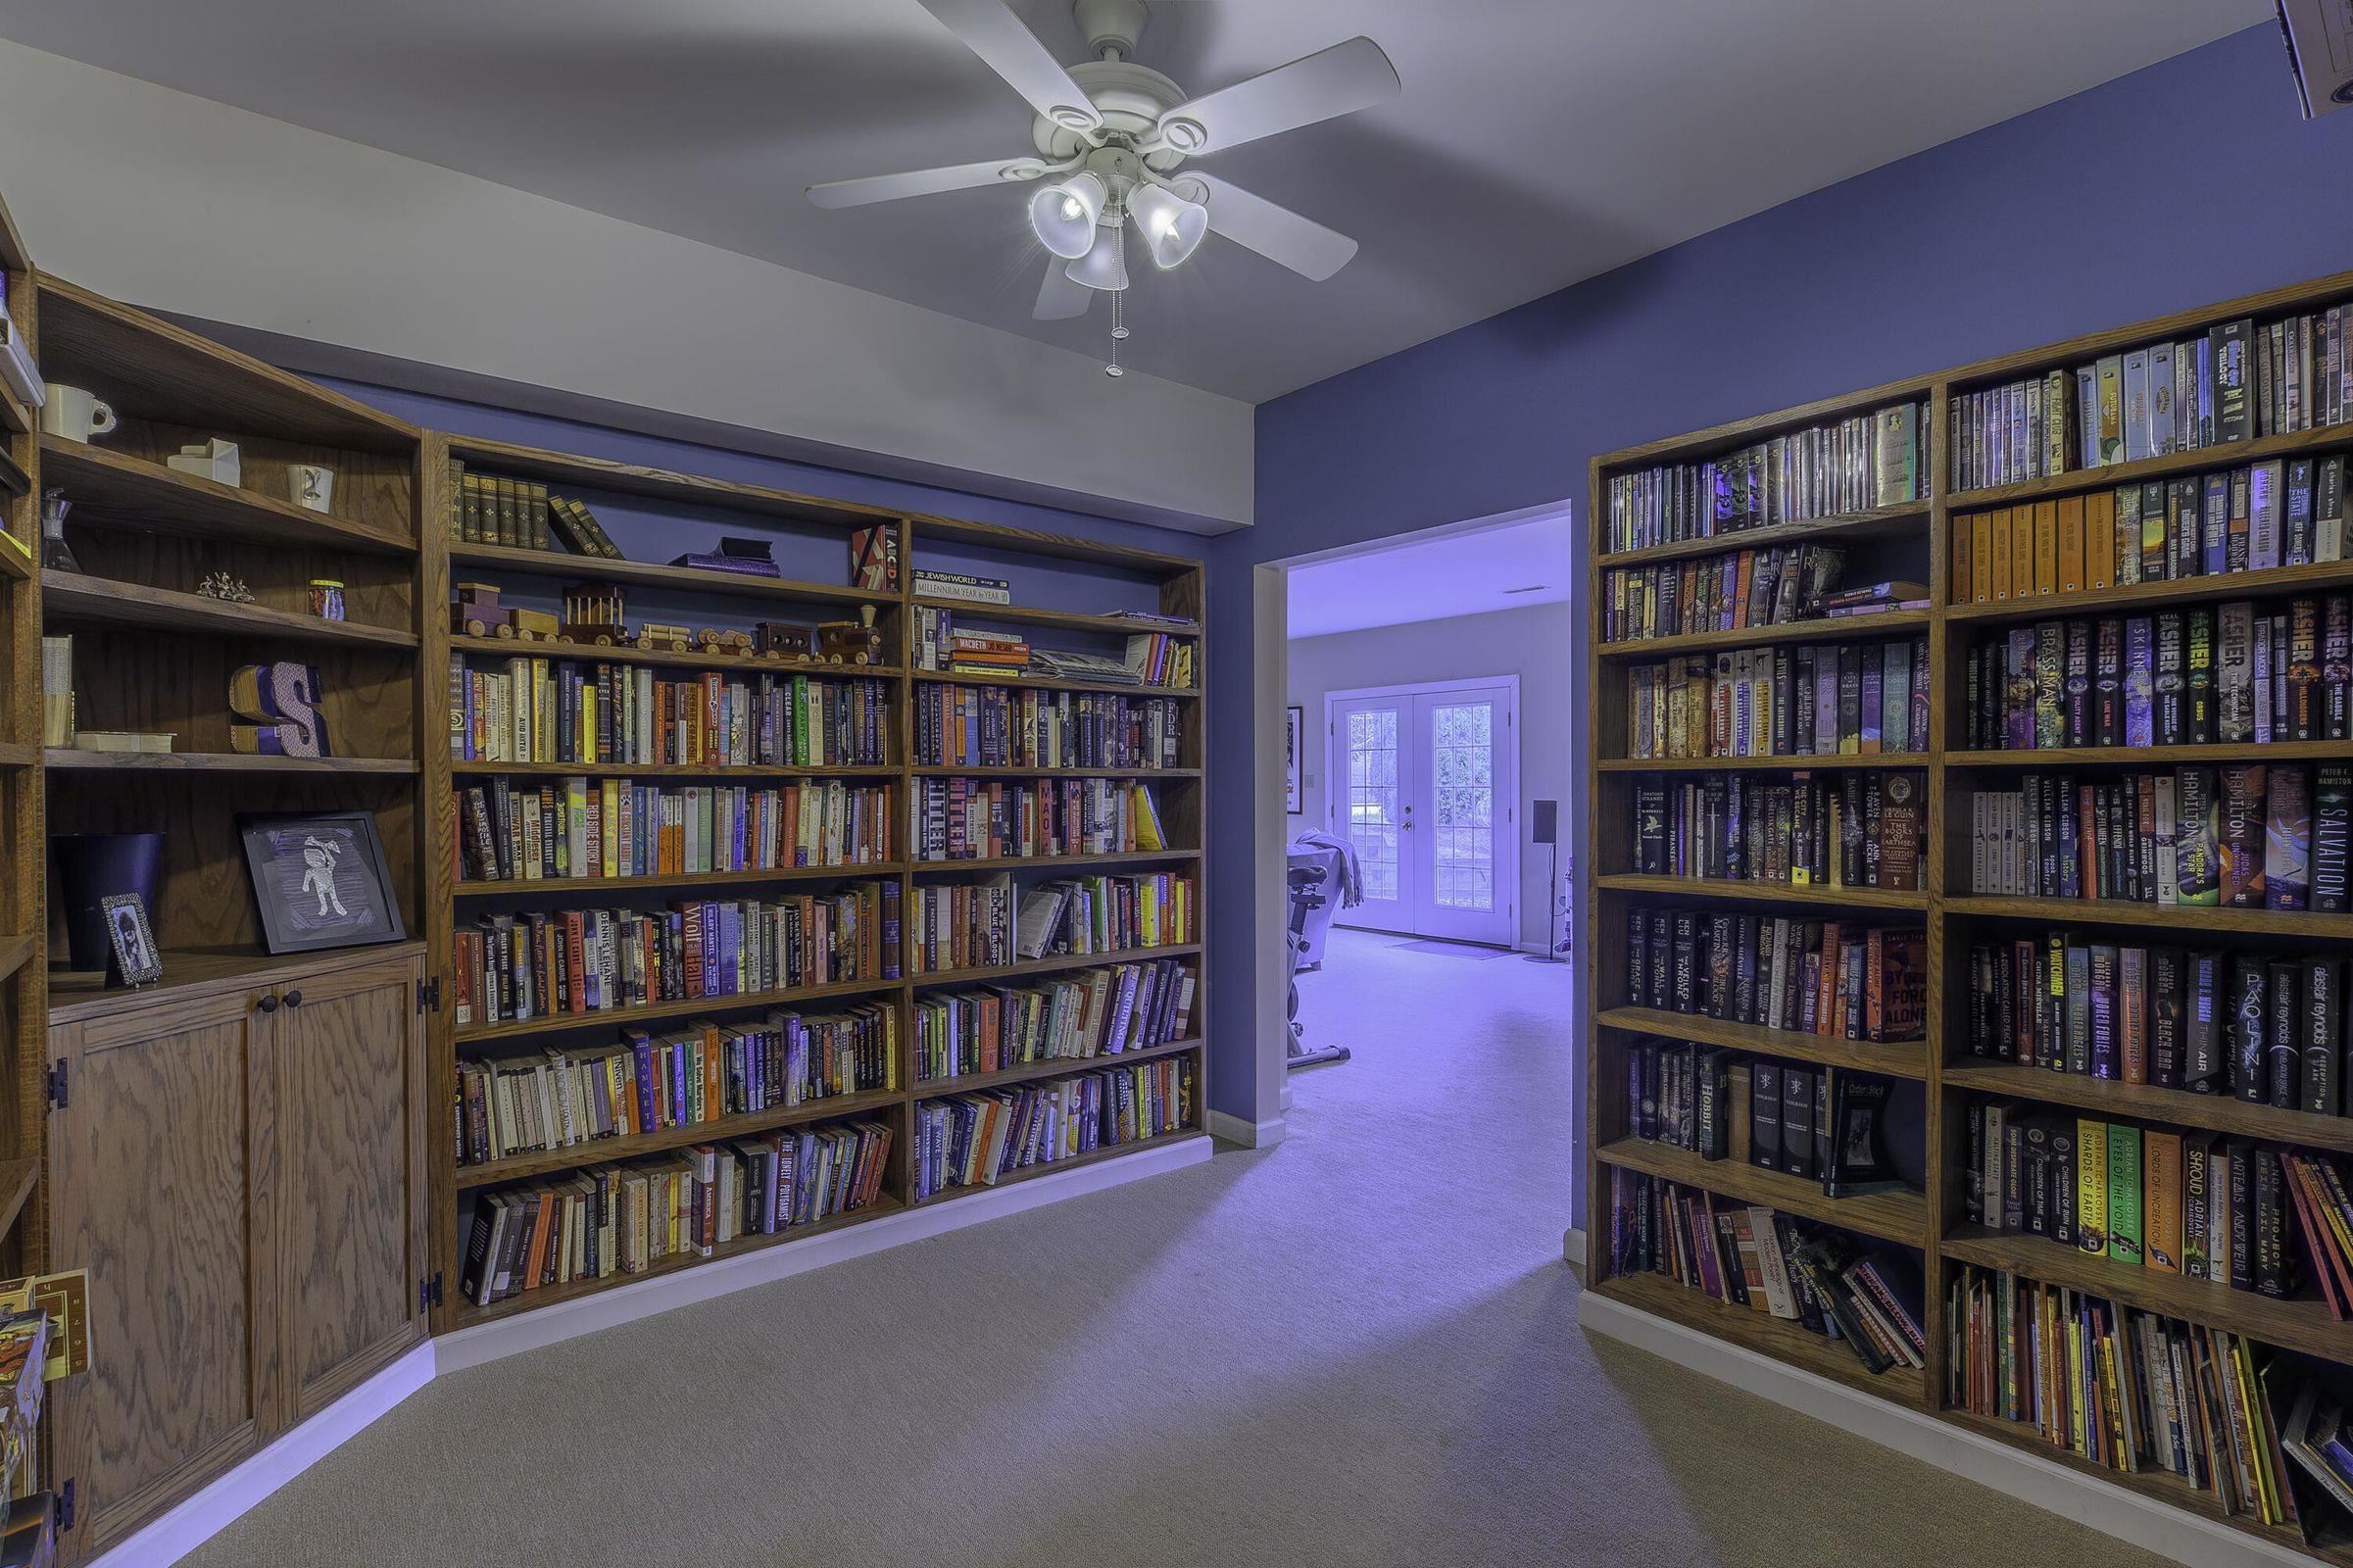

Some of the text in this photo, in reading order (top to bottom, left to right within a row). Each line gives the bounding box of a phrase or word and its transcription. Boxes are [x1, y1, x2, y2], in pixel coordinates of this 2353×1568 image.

[2052, 398, 2062, 436] FIGHT CLUB
[2291, 496, 2301, 517] STATE
[2181, 510, 2190, 560] ENDER'S GAME
[2293, 521, 2303, 554] JEFF SOMERS
[917, 583, 960, 596] MILLENNIUM
[961, 588, 976, 597] YEAR
[984, 590, 999, 600] YEAR
[925, 572, 977, 585] JEWISH WORLD
[959, 638, 987, 651] MACBETH
[2069, 628, 2087, 676] ASHER
[2159, 621, 2180, 672] ASHER
[2188, 617, 2210, 669] ASHER
[2224, 616, 2245, 667] ASHER
[2292, 606, 2314, 662] ASHER
[2326, 603, 2349, 660] ASHER
[1777, 658, 1788, 680] DEVILS
[2041, 629, 2056, 708] BRASS MAN
[2334, 683, 2343, 695] THE
[474, 676, 485, 719] STAY WITH ME
[2075, 697, 2083, 734] POLITY AGENT
[517, 716, 526, 732] AYAD
[930, 780, 945, 853] HITLER
[950, 777, 965, 853] HITLER
[2043, 780, 2052, 842] WILLIAM GIBSON
[2182, 772, 2200, 839] HAMILTON
[2229, 770, 2246, 839] HAMILTON
[513, 817, 521, 838] WAR
[530, 819, 540, 861] Middlesex
[587, 805, 600, 863] RED SIDE STORY
[621, 813, 631, 863] CONSTANT RABBIT
[2061, 814, 2070, 841] GIBSON
[2059, 856, 2071, 882] history
[2140, 837, 2149, 875] GRIMWOOD
[2187, 854, 2196, 873] STAR
[2195, 843, 2206, 885] PANDORA'S
[2240, 852, 2250, 876] JUDAS
[2316, 808, 2348, 897] SALVATION
[558, 938, 566, 956] JOHN
[570, 918, 580, 940] JOHN
[601, 912, 612, 988] DENNIS LEHANE
[684, 906, 703, 984] Wolf Hall
[707, 908, 715, 956] HILARY MANTEL
[828, 931, 837, 953] Split
[1713, 918, 1722, 953] MARTIN
[501, 958, 510, 974] PEACE
[2050, 949, 2064, 998] WATCHMEN
[2094, 956, 2106, 992] MORGAN
[1735, 977, 1750, 1011] KRAKEN
[1787, 984, 1796, 1019] DRAGONS
[2035, 988, 2045, 1025] MIÉVILLE
[2277, 973, 2291, 1044] alastair reynolds
[2310, 966, 2328, 1045] alastair reynolds
[1116, 991, 1135, 1041] QUILTING
[2244, 973, 2261, 1081] PAOLINI
[696, 1055, 704, 1065] We
[2158, 1019, 2172, 1070] BLACK MAN
[614, 1061, 624, 1090] Niven
[1701, 1083, 1714, 1133] HOBBIT
[778, 1140, 793, 1221] THE LONELY POLYGAMIST
[2035, 1158, 2044, 1190] CHILDREN
[2061, 1165, 2070, 1198] CHILDREN
[2083, 1132, 2093, 1225] SHARDS OF EARTH
[2113, 1138, 2124, 1231] EYES OF THE VOID
[2125, 1140, 2135, 1234] ADRIAN TCHAIKOVSKY
[2188, 1150, 2205, 1195] SHROUD
[2151, 1146, 2161, 1245] LORDS OF UNCREATION
[2194, 1199, 2205, 1239] ADRIAN
[2272, 1208, 2280, 1268] PROJECT
[1768, 1235, 1780, 1256] Norton
[2232, 1210, 2246, 1272] ANDY WEIR
[2260, 1240, 2269, 1270] MARY
